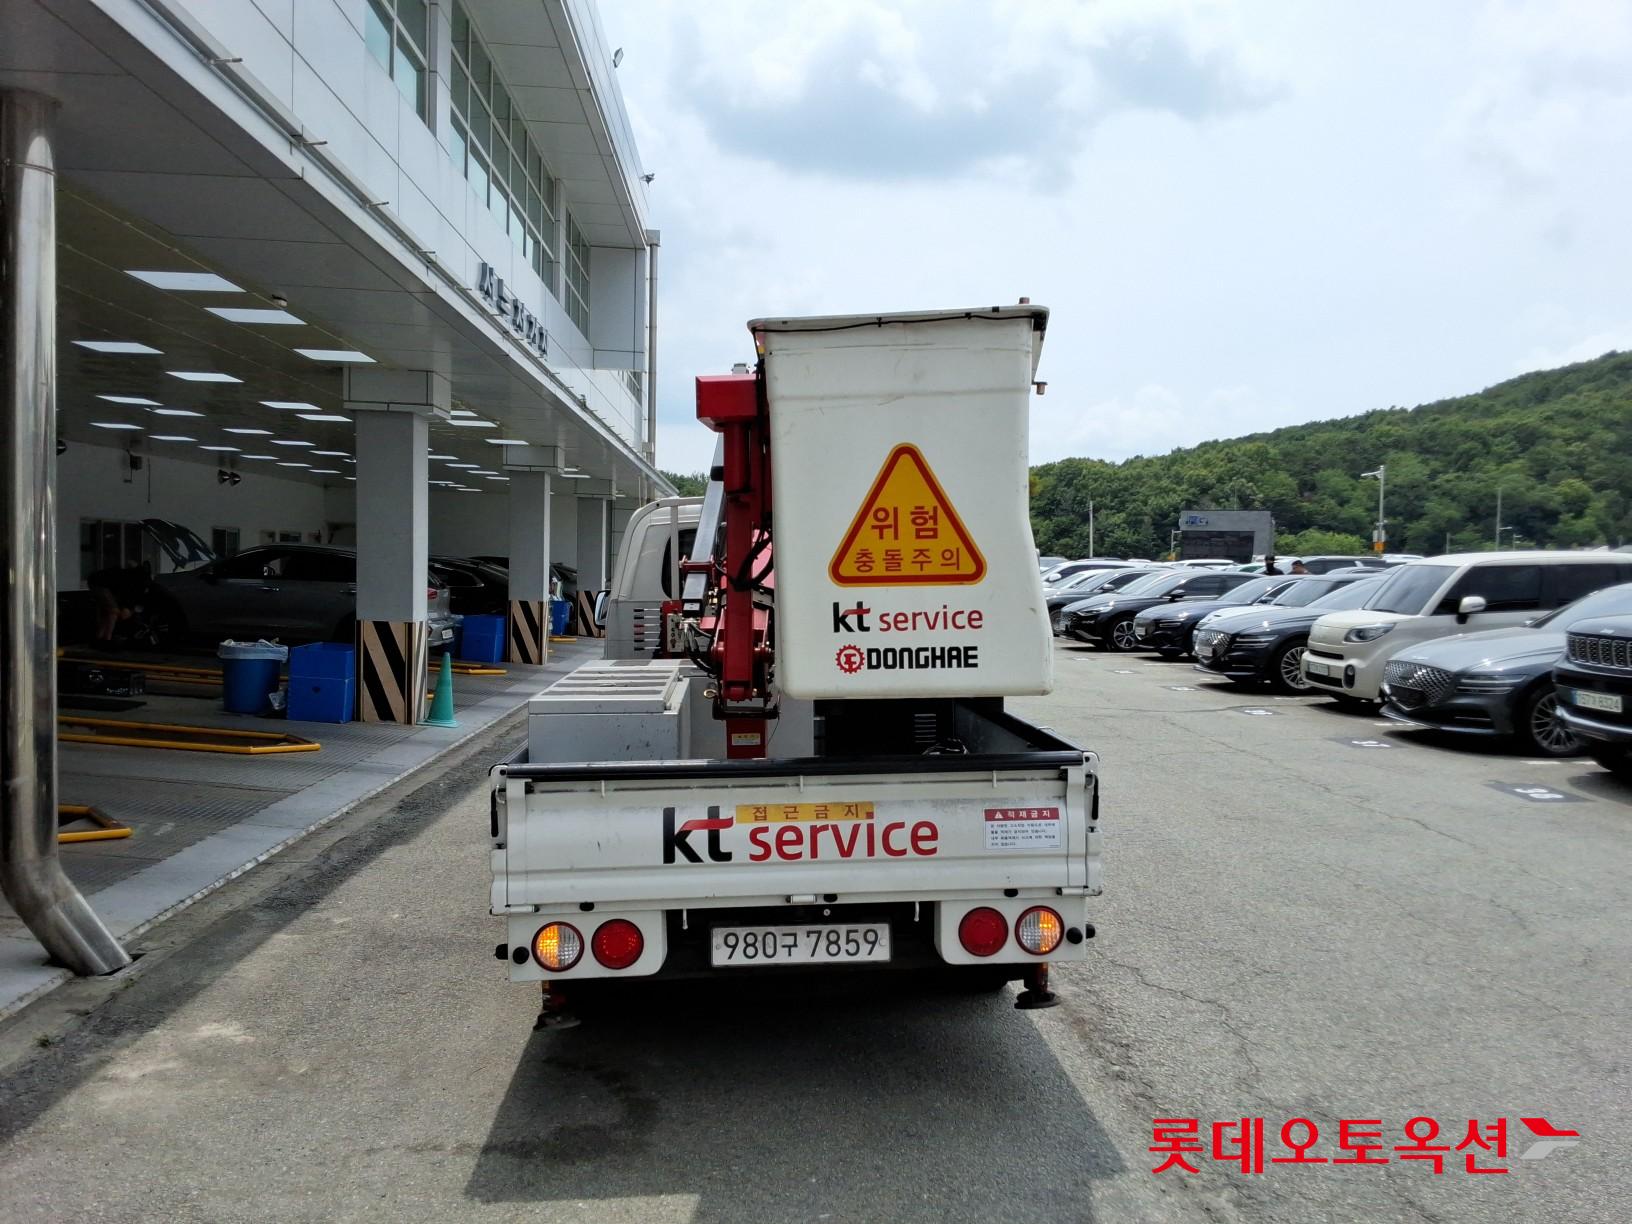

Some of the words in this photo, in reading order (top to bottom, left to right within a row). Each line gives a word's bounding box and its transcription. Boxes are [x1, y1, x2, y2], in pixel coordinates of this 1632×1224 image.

[871, 505, 939, 541] 위험
[854, 547, 960, 573] 충돌주의
[833, 601, 871, 633] kt
[879, 604, 983, 632] service
[866, 646, 978, 670] DONGHAE
[752, 803, 860, 822] 접근금지
[663, 805, 734, 865] kt
[749, 812, 939, 862] service
[723, 931, 798, 960] 980구
[806, 928, 880, 958] 7859
